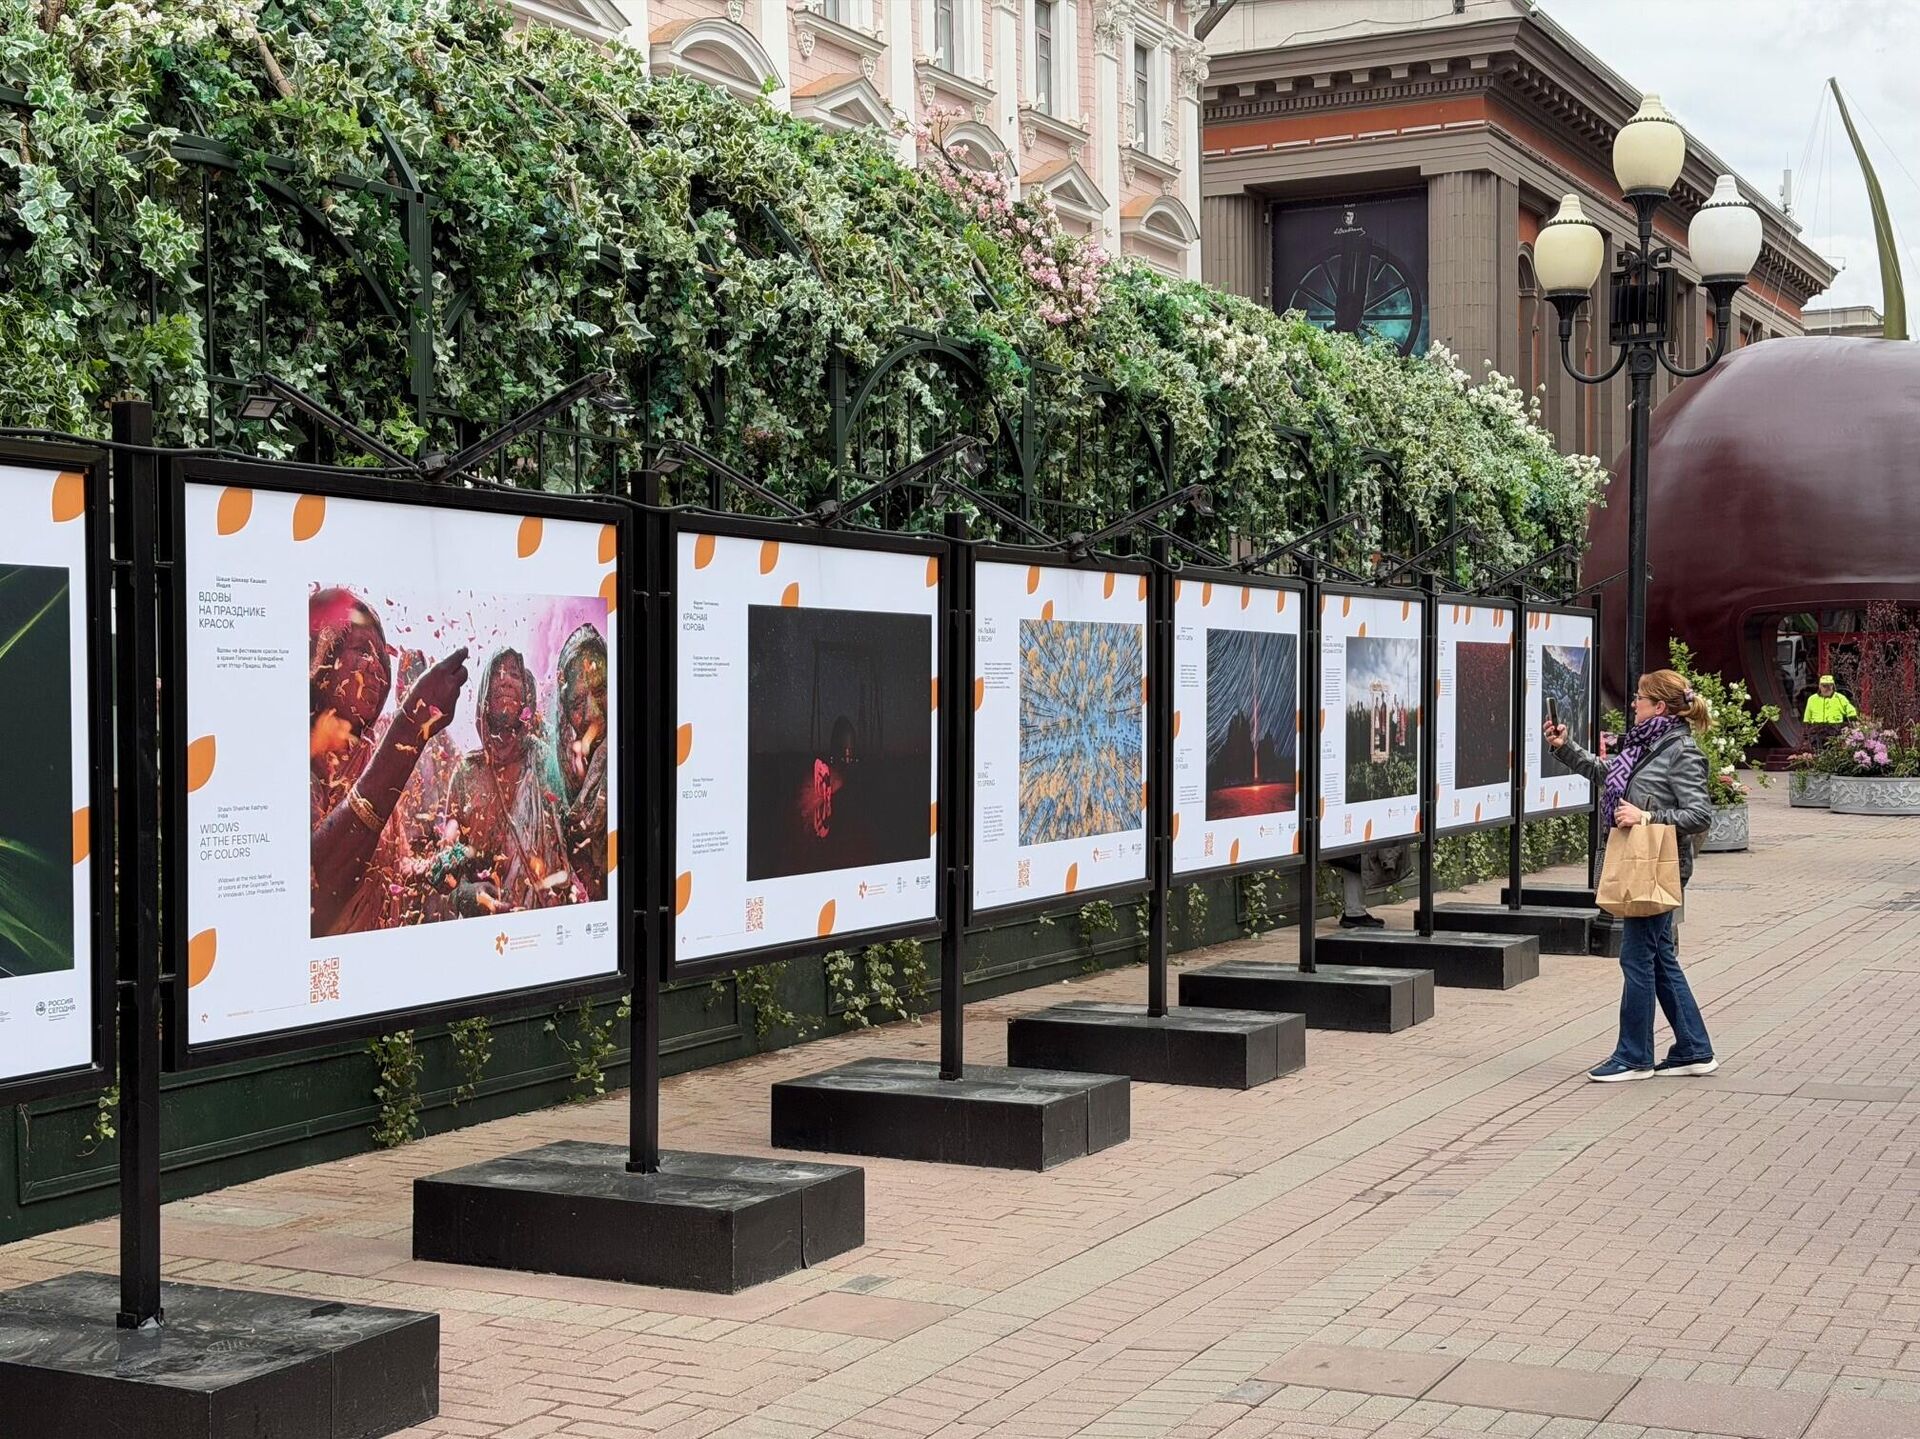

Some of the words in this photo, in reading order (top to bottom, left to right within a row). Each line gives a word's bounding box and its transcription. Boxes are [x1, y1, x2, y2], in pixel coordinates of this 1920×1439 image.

[199, 591, 232, 603] ВДОВЫ
[199, 605, 212, 615] НА
[214, 605, 266, 618] ПРАЗДНИКЕ
[199, 618, 235, 630] КРАСОК
[200, 822, 240, 834] WIDOWS
[200, 837, 210, 848] AT
[212, 836, 229, 846] THE
[231, 832, 271, 845] FESTIVAL
[200, 850, 212, 861] OF
[214, 847, 251, 860] COLORS
[48, 997, 74, 1007] РОССИЯ
[48, 1004, 76, 1015] СЕГОДНЯ
